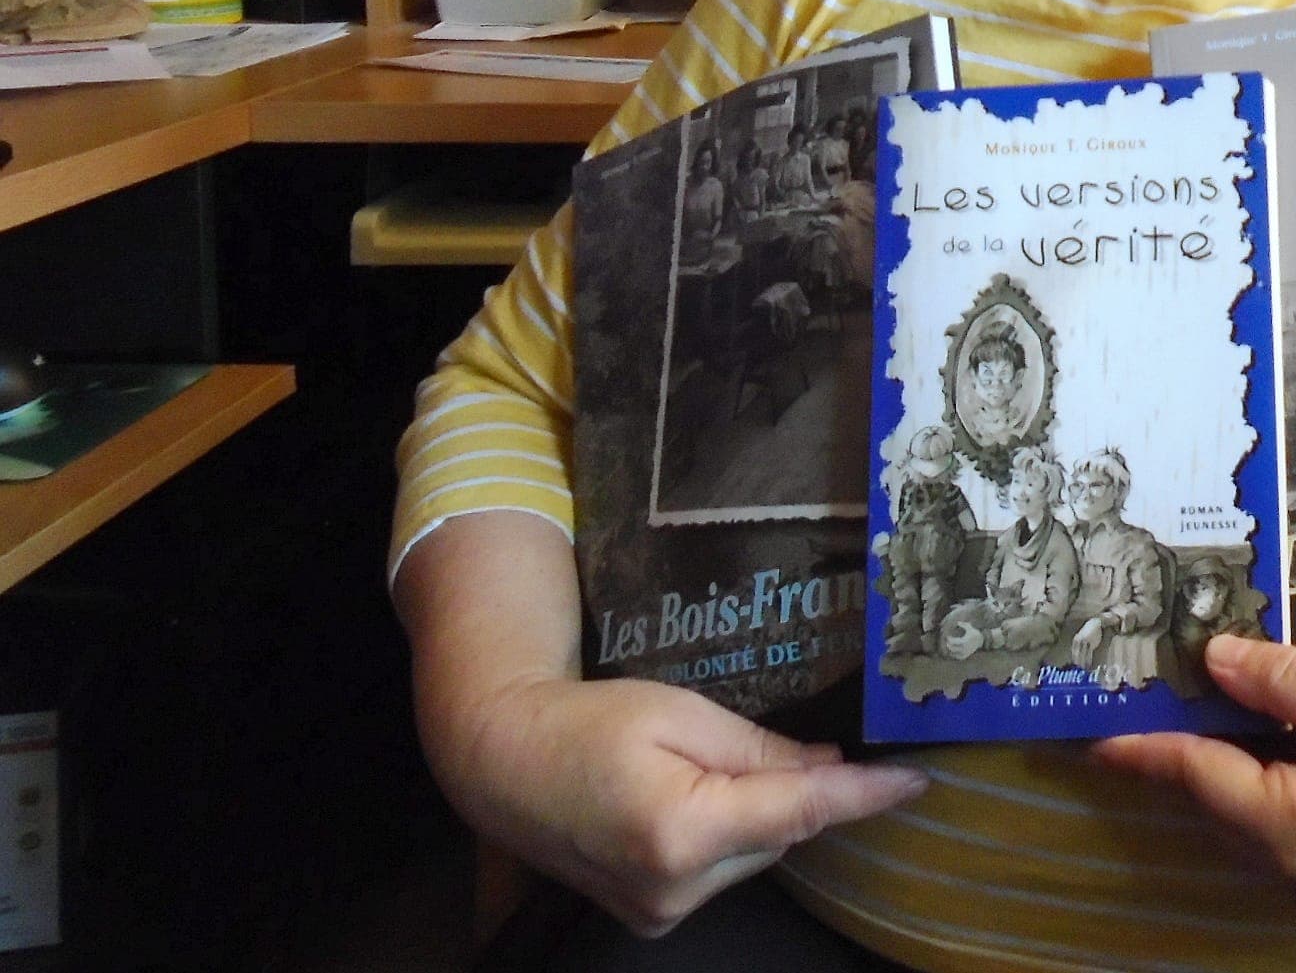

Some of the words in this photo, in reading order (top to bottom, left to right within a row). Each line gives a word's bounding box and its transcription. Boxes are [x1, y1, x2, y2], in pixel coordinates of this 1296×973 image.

[913, 182, 996, 213] Les
[1020, 174, 1219, 210] versions
[942, 236, 976, 255] de
[983, 235, 1004, 253] la
[1021, 216, 1213, 267] vérité
[1180, 506, 1223, 515] ROMAN
[1180, 519, 1238, 532] JEUNESSE
[598, 610, 648, 666] Les
[767, 640, 803, 667] DE
[1009, 665, 1031, 686] La
[1038, 665, 1085, 685] Plume
[1011, 692, 1128, 707] ÉDITION
